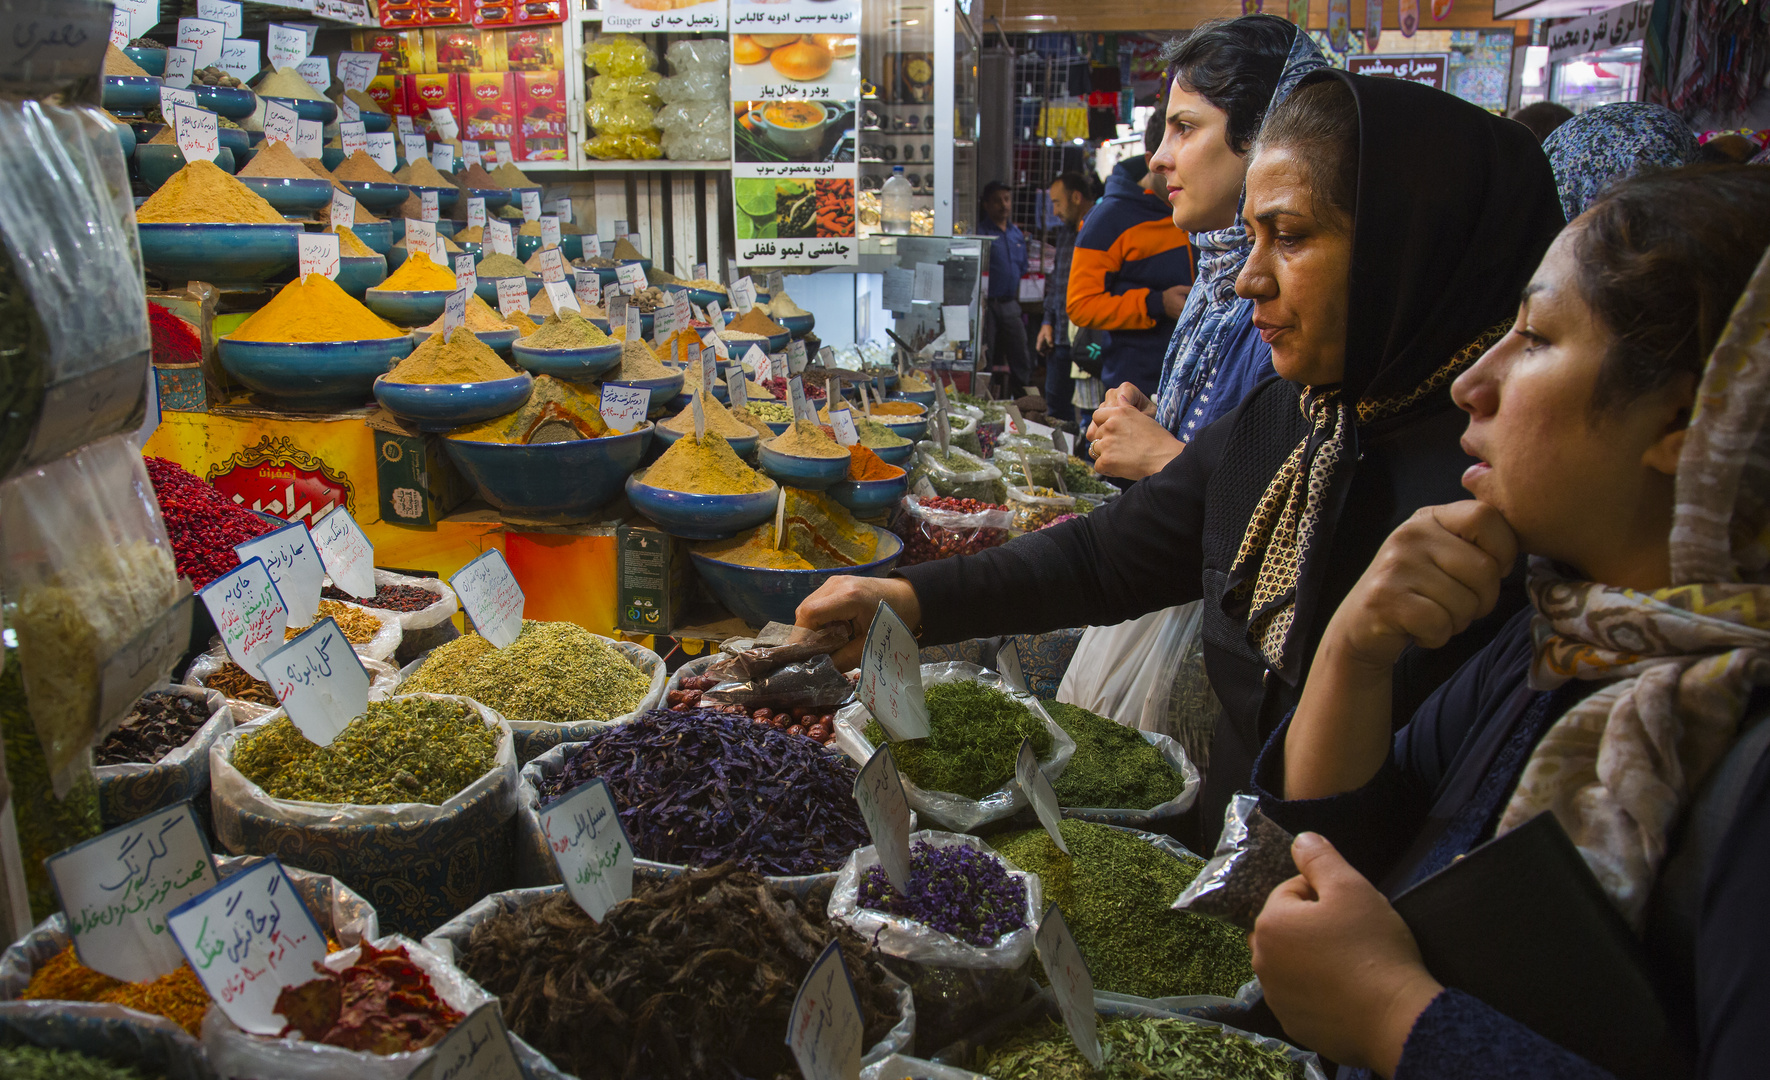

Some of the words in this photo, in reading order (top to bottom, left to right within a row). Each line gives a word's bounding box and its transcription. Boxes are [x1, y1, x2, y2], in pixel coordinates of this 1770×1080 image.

[607, 16, 642, 27] Ginger
[667, 16, 683, 26] حبه
[686, 14, 720, 27] زنجبیل
[734, 13, 765, 25] کالباس
[768, 12, 790, 24] ادویه
[795, 13, 828, 24] سوسیس
[830, 11, 852, 24] ادویه
[1356, 58, 1394, 76] مشیر
[1394, 59, 1438, 77] سرای
[760, 86, 775, 98] پیاز
[777, 86, 799, 98] خلال
[802, 88, 808, 97] و
[811, 87, 829, 98] پودر
[756, 165, 775, 177] سوپ
[777, 164, 811, 176] مخصوص
[814, 164, 835, 175] ادویه
[743, 242, 776, 260] فلفلی
[780, 242, 804, 258] لیمو
[808, 242, 850, 260] چاشنی
[258, 467, 297, 481] زعفران
[288, 543, 306, 569] بهار
[315, 633, 333, 677] گل
[286, 655, 320, 686] بابونه
